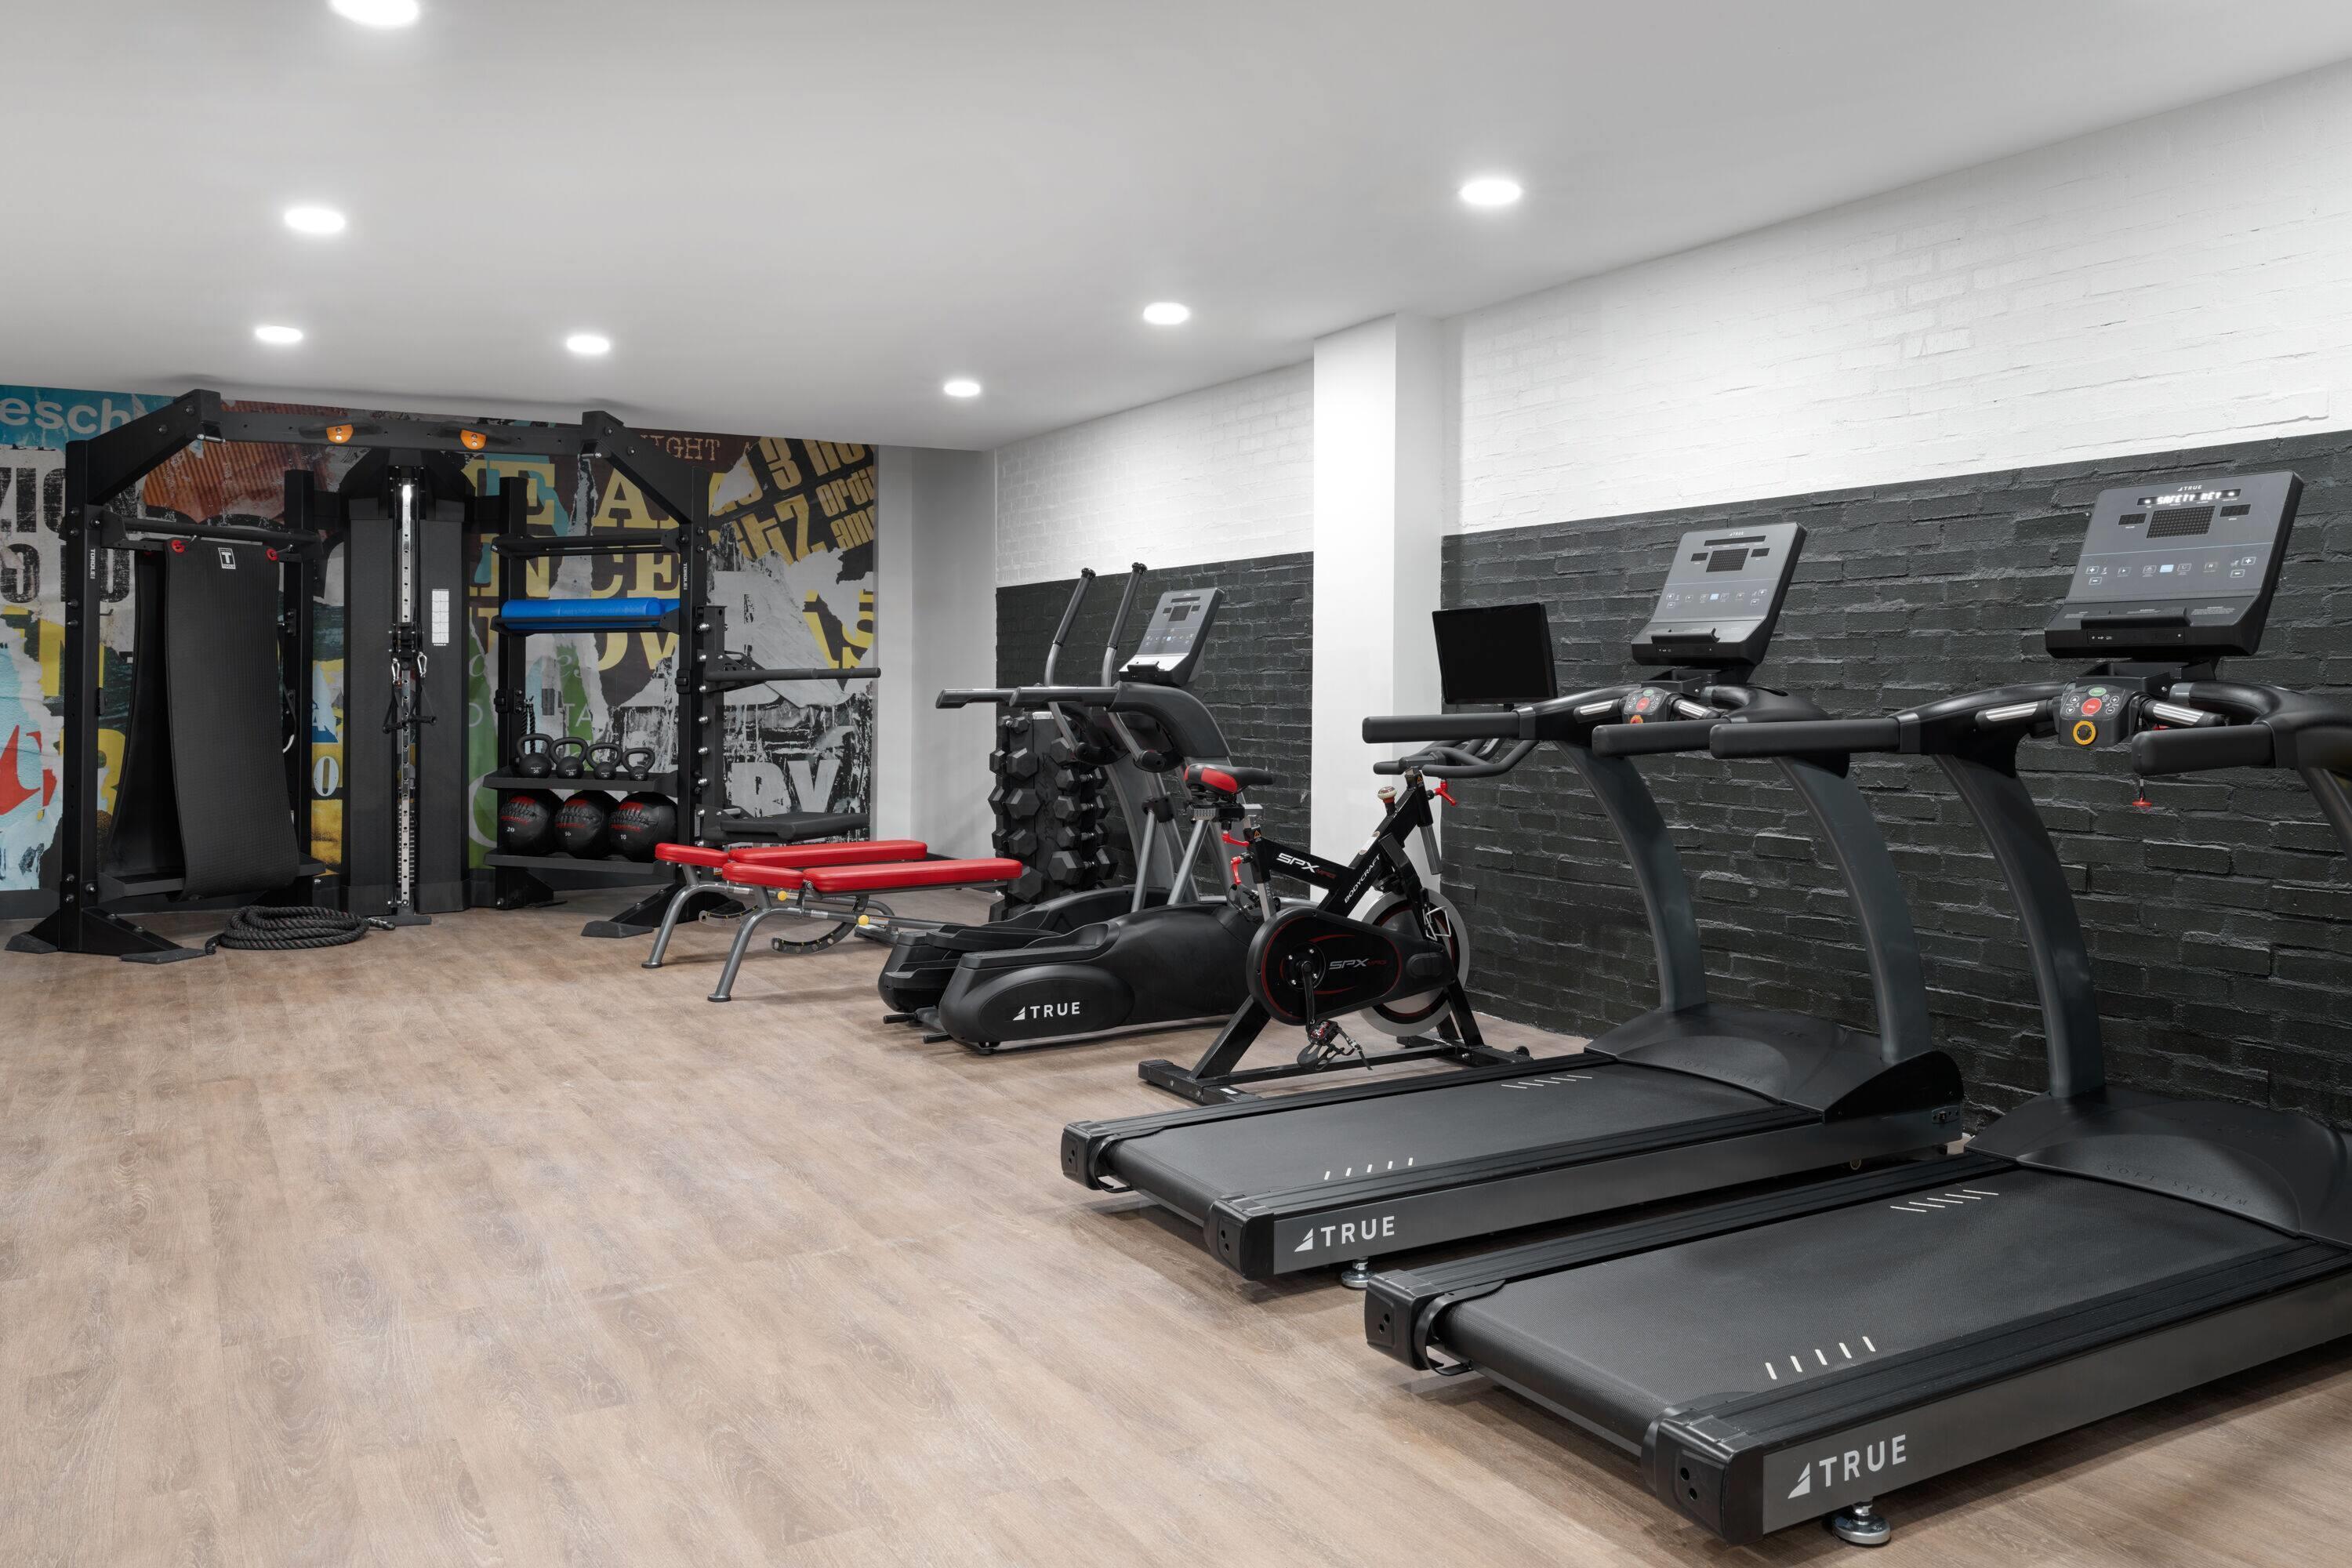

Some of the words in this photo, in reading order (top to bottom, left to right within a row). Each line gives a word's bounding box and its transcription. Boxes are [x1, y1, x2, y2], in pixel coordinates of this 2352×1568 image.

[2156, 494, 2196, 506] SAFETY
[1276, 852, 1319, 873] SPX
[1344, 853, 1381, 903] BODYCRAFT
[1329, 958, 1370, 970] SPX
[1029, 1001, 1080, 1018] TRUE
[2104, 1164, 2156, 1181] SOFT
[2172, 1180, 2248, 1206] SYSTEM
[1320, 1215, 1395, 1247] TRUE
[1819, 1434, 1907, 1487] TRUE
